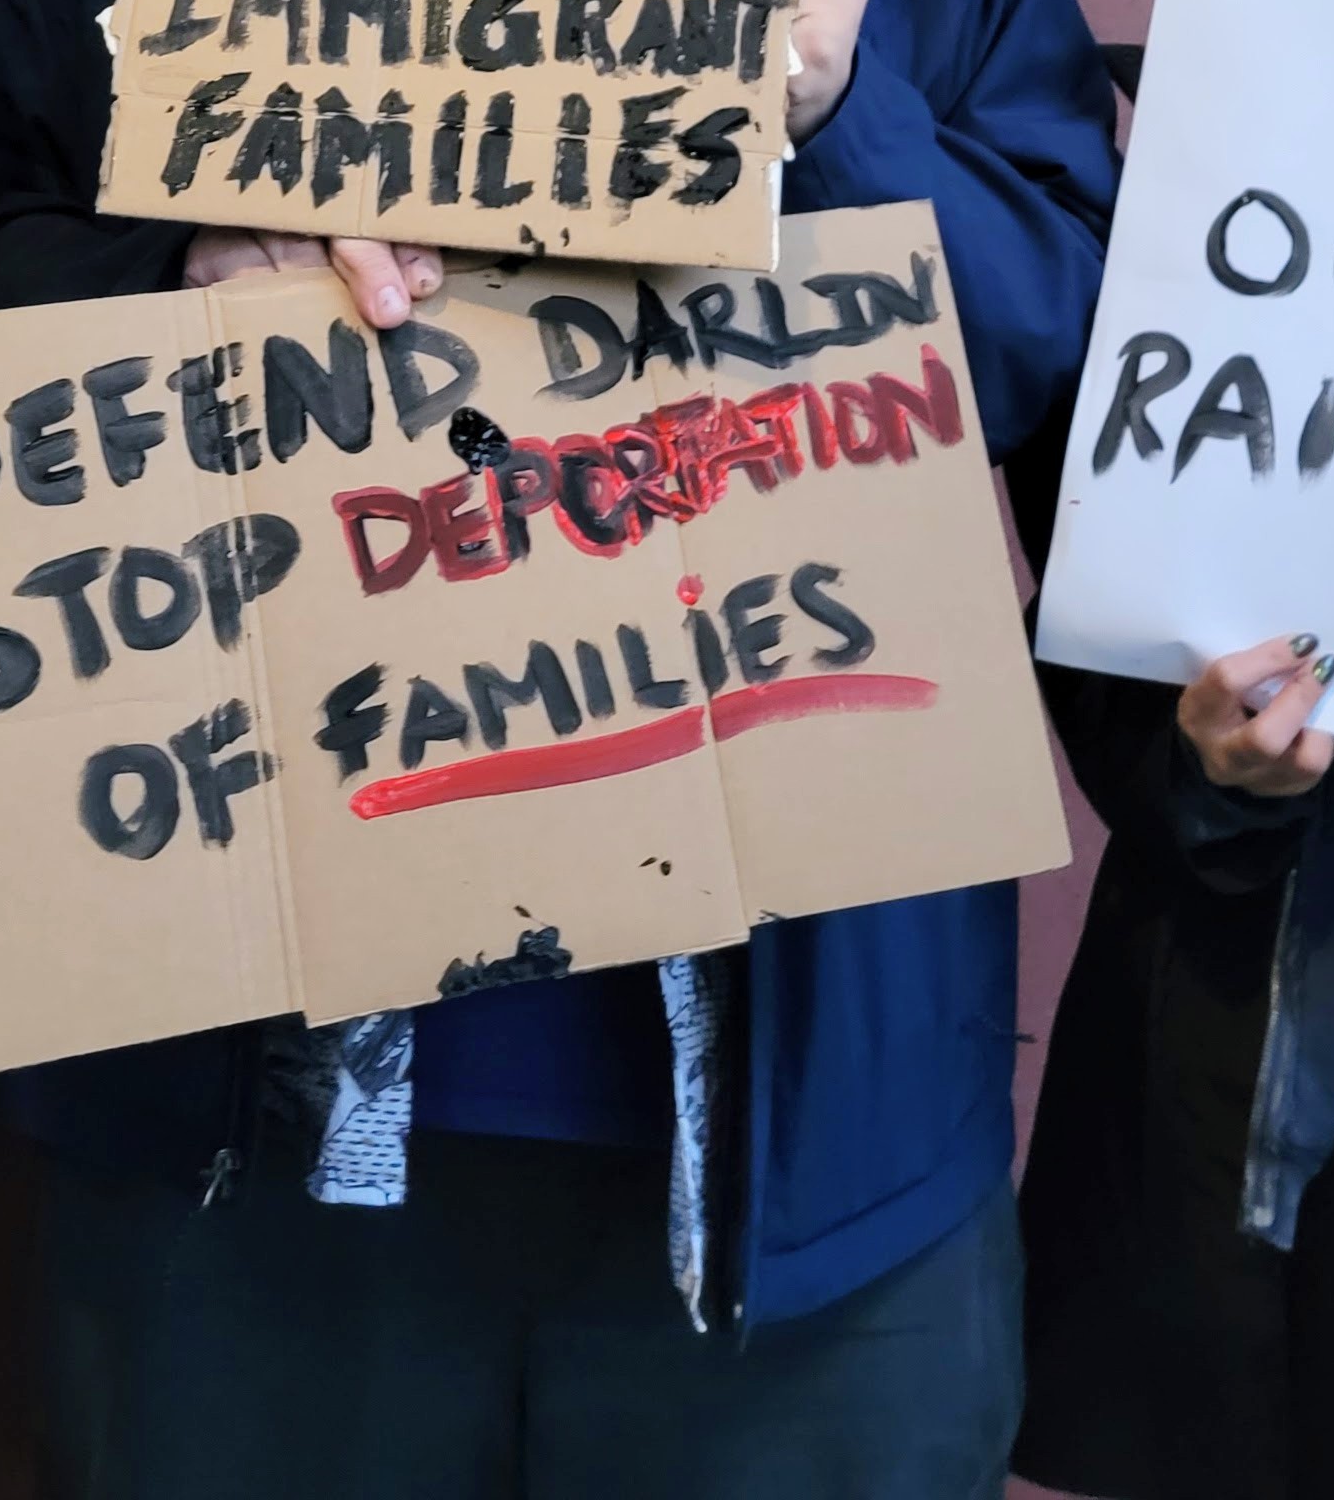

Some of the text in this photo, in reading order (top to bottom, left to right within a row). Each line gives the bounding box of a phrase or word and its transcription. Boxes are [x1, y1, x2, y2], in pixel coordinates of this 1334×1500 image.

[160, 71, 751, 218] FAMILIES
[528, 249, 942, 403] DARLIN
[330, 343, 966, 596] DEPORTATION
[77, 698, 283, 861] OF
